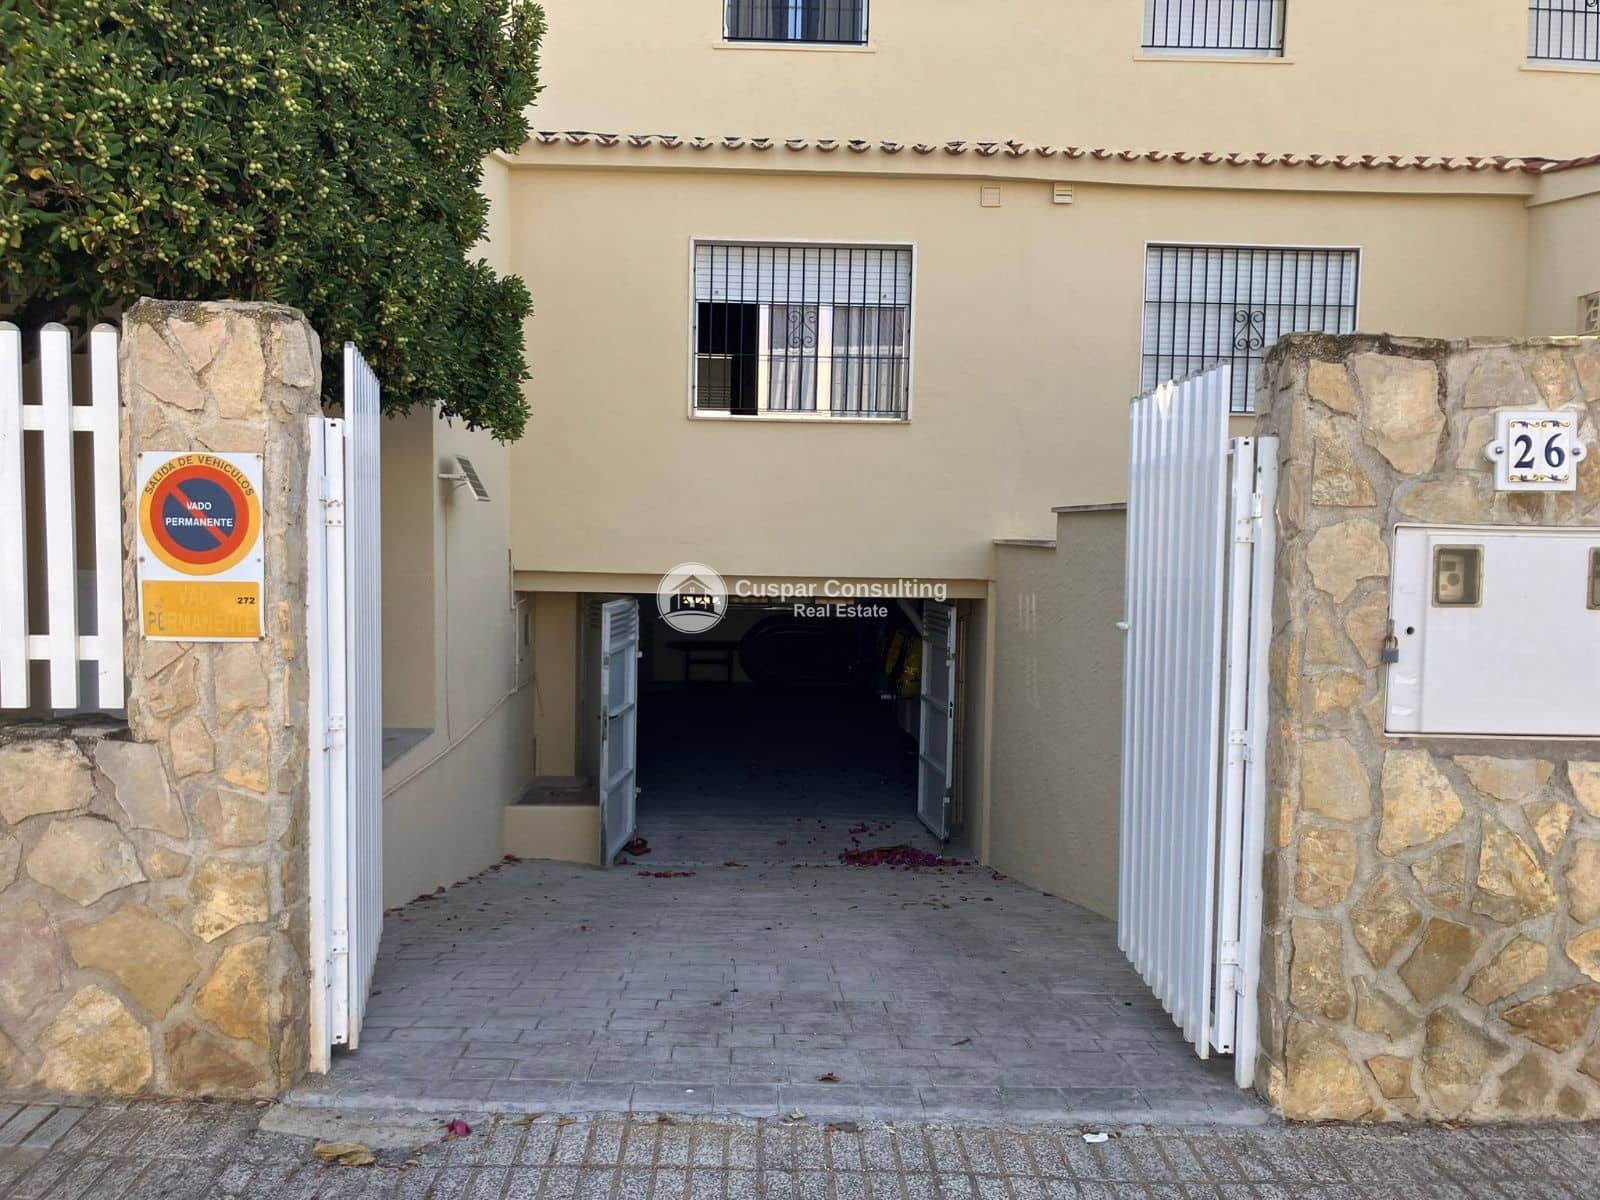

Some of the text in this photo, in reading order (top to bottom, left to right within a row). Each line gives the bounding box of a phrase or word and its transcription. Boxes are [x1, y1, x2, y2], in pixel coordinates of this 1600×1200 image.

[1513, 432, 1566, 469] 26
[145, 455, 255, 497] SALIDA DE VEHICULOS
[186, 502, 212, 511] VADO
[165, 517, 233, 527] PERMANENTE
[237, 596, 256, 605] 272
